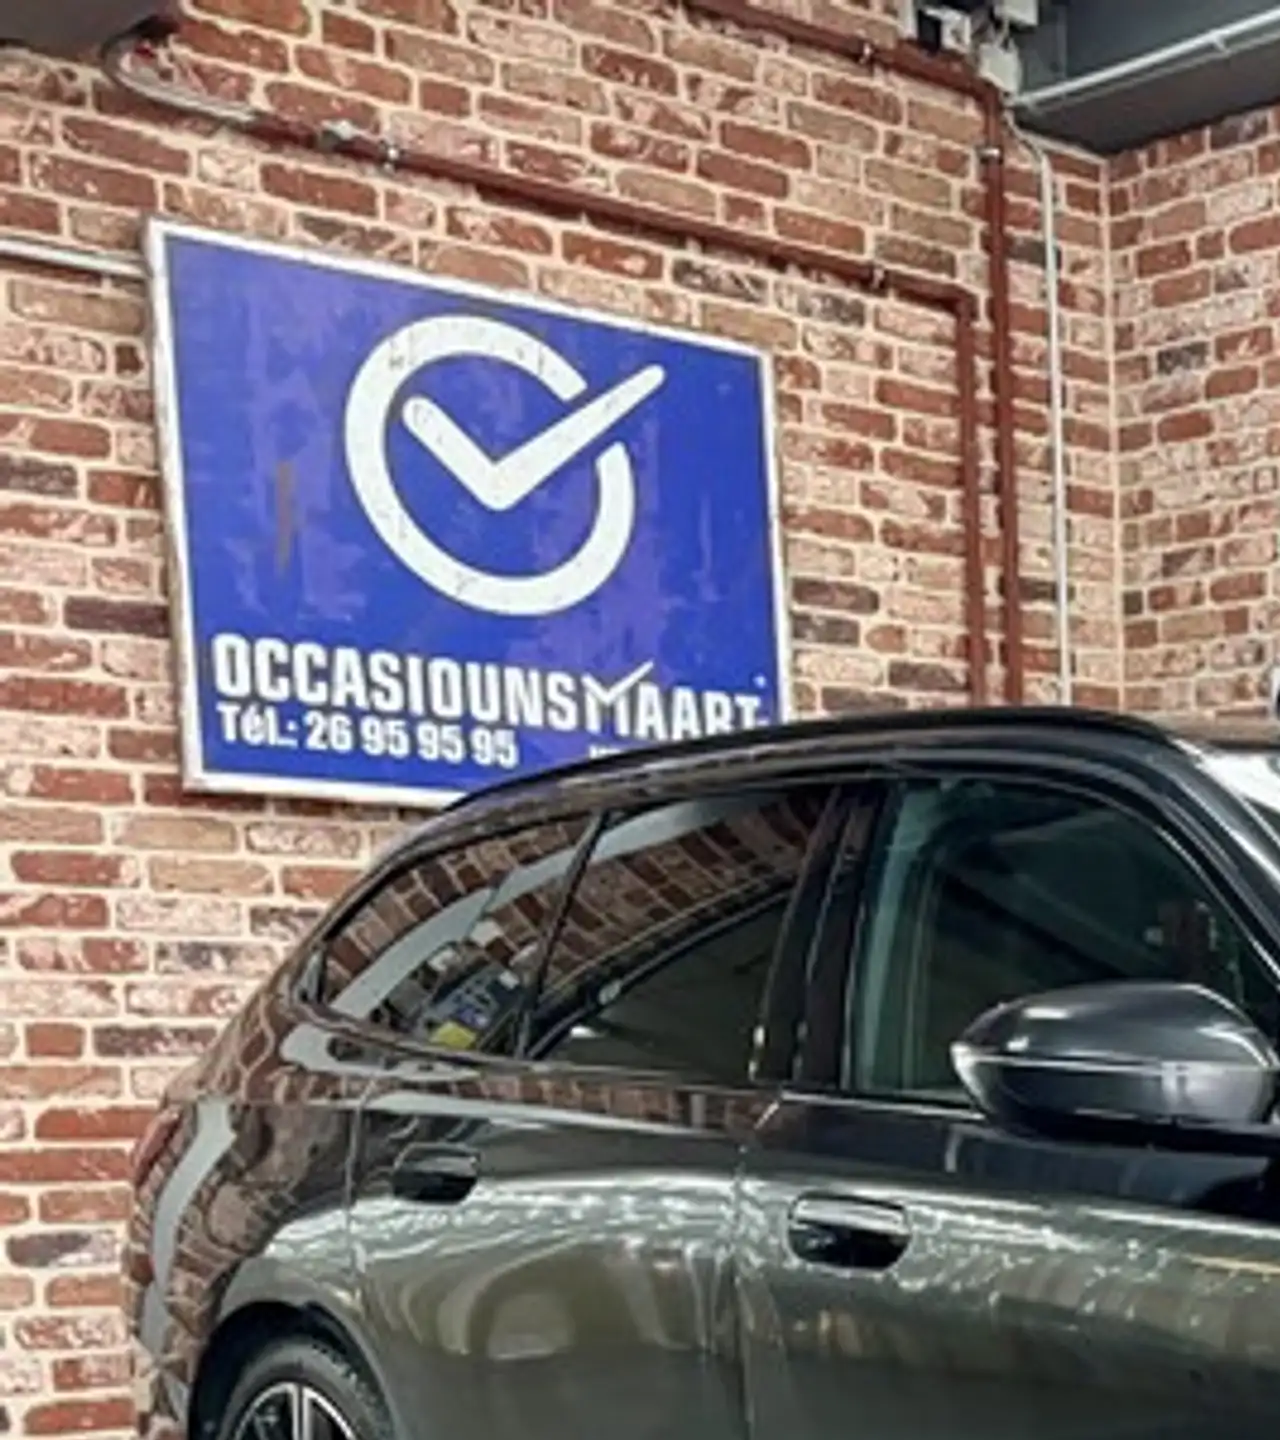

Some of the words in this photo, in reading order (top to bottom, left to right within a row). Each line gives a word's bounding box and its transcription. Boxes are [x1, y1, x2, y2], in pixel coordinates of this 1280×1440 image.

[303, 711, 354, 752] 26
[360, 715, 409, 757] 95
[416, 721, 466, 763] 95
[470, 727, 519, 768] 95
